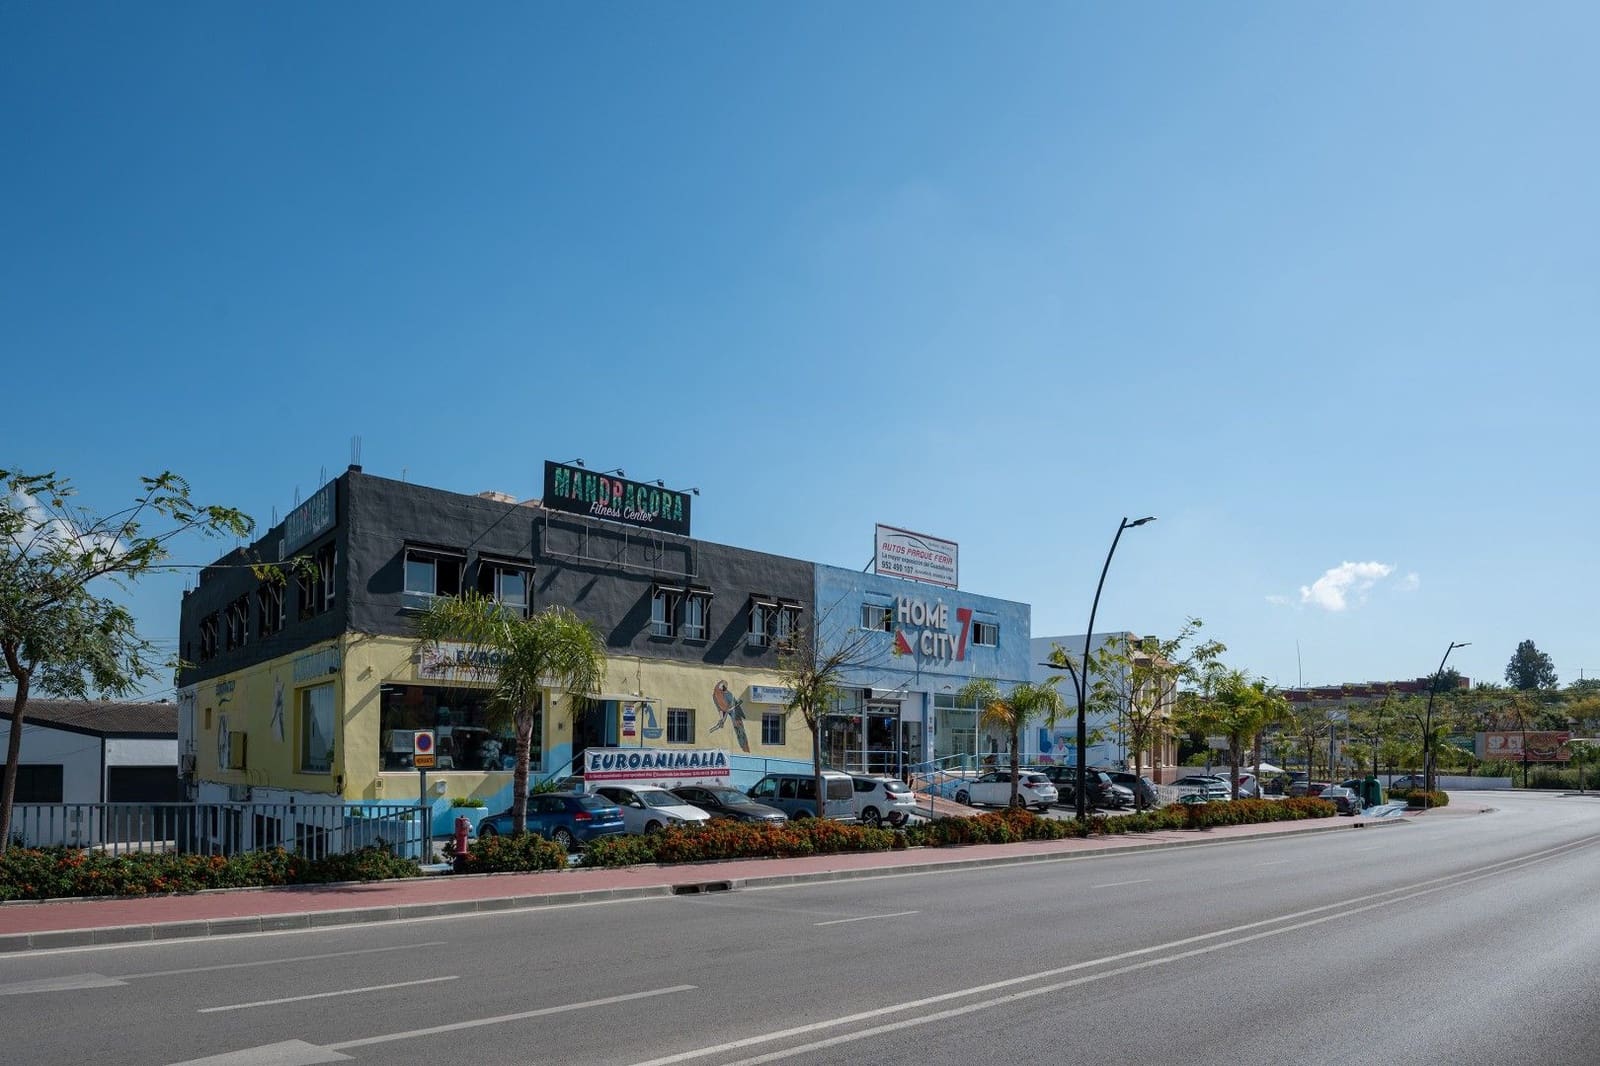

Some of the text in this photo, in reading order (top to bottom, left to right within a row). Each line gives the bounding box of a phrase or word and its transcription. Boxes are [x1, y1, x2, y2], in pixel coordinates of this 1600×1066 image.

[554, 467, 683, 521] MANDRAGORA
[589, 501, 654, 522] Fitness Center
[882, 542, 906, 555] AUTOS
[906, 548, 933, 561] PARQUE
[881, 561, 892, 570] 952
[897, 595, 949, 629] HOME
[920, 630, 959, 660] CITY
[590, 752, 726, 770] EUROANIMALIA
